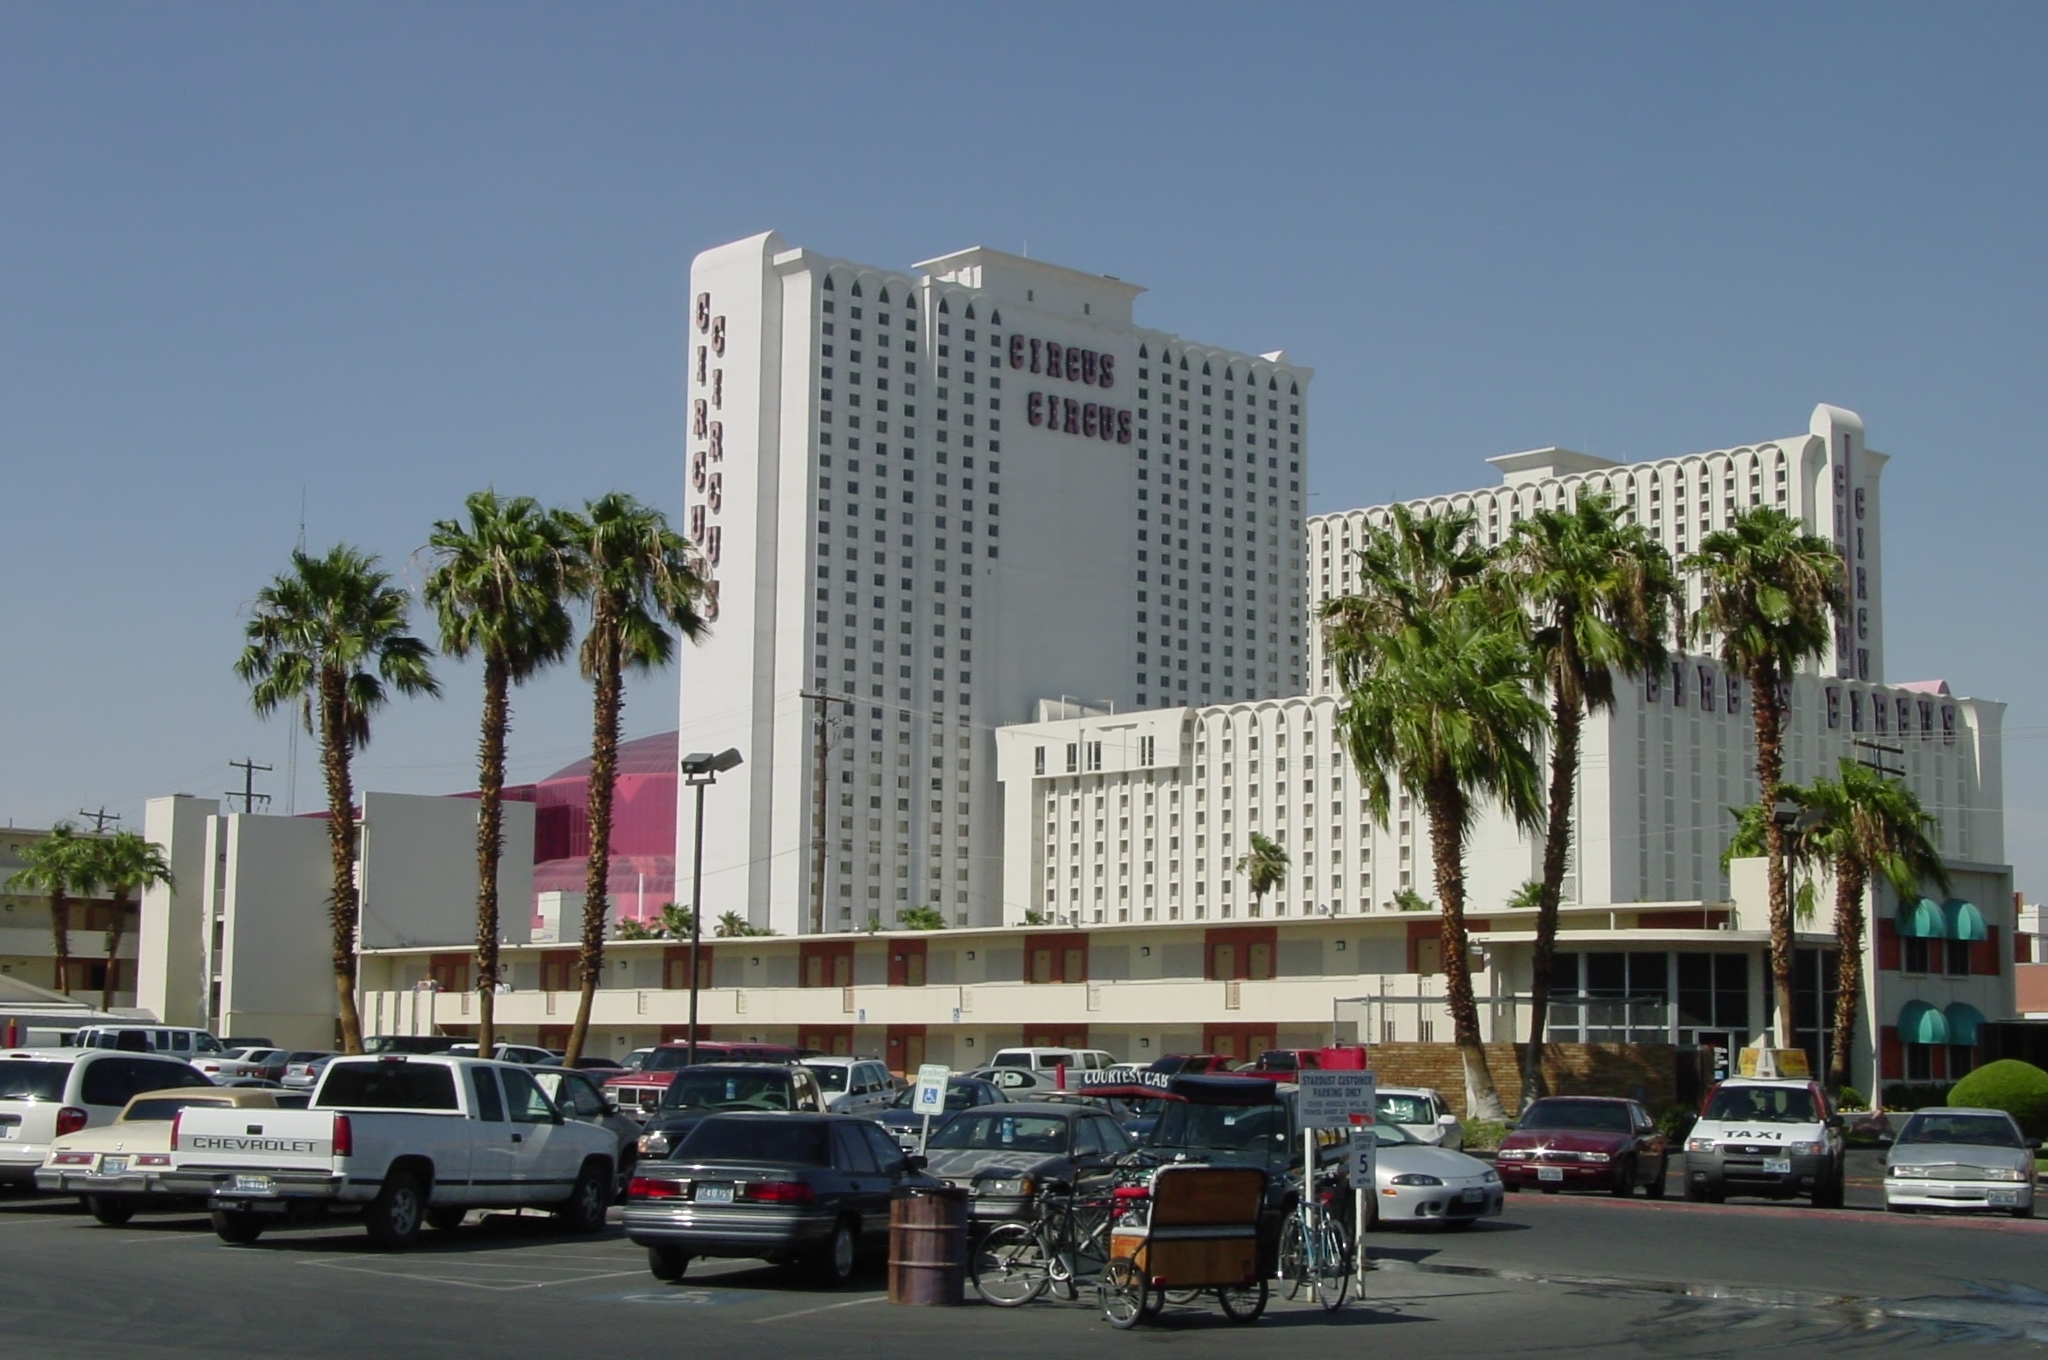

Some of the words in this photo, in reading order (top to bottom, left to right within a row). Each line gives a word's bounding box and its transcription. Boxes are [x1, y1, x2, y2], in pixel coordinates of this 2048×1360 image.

[1010, 334, 1115, 388] CIRCUS
[1028, 391, 1132, 444] CIRCUS
[704, 314, 726, 622] CIRCUS
[1855, 487, 1870, 681] CIRCU
[1825, 686, 1957, 745] CIRCUS
[1084, 1069, 1144, 1084] COURTESY
[1145, 1071, 1169, 1088] CAB
[1302, 1075, 1336, 1086] STARDUST
[1338, 1075, 1373, 1086] CUSTOMER
[1313, 1087, 1343, 1098] PARKING
[1345, 1088, 1362, 1097] ONLY
[193, 1137, 318, 1152] CHEVROLET
[1723, 1130, 1783, 1140] TAXI
[1358, 1153, 1368, 1174] 5
